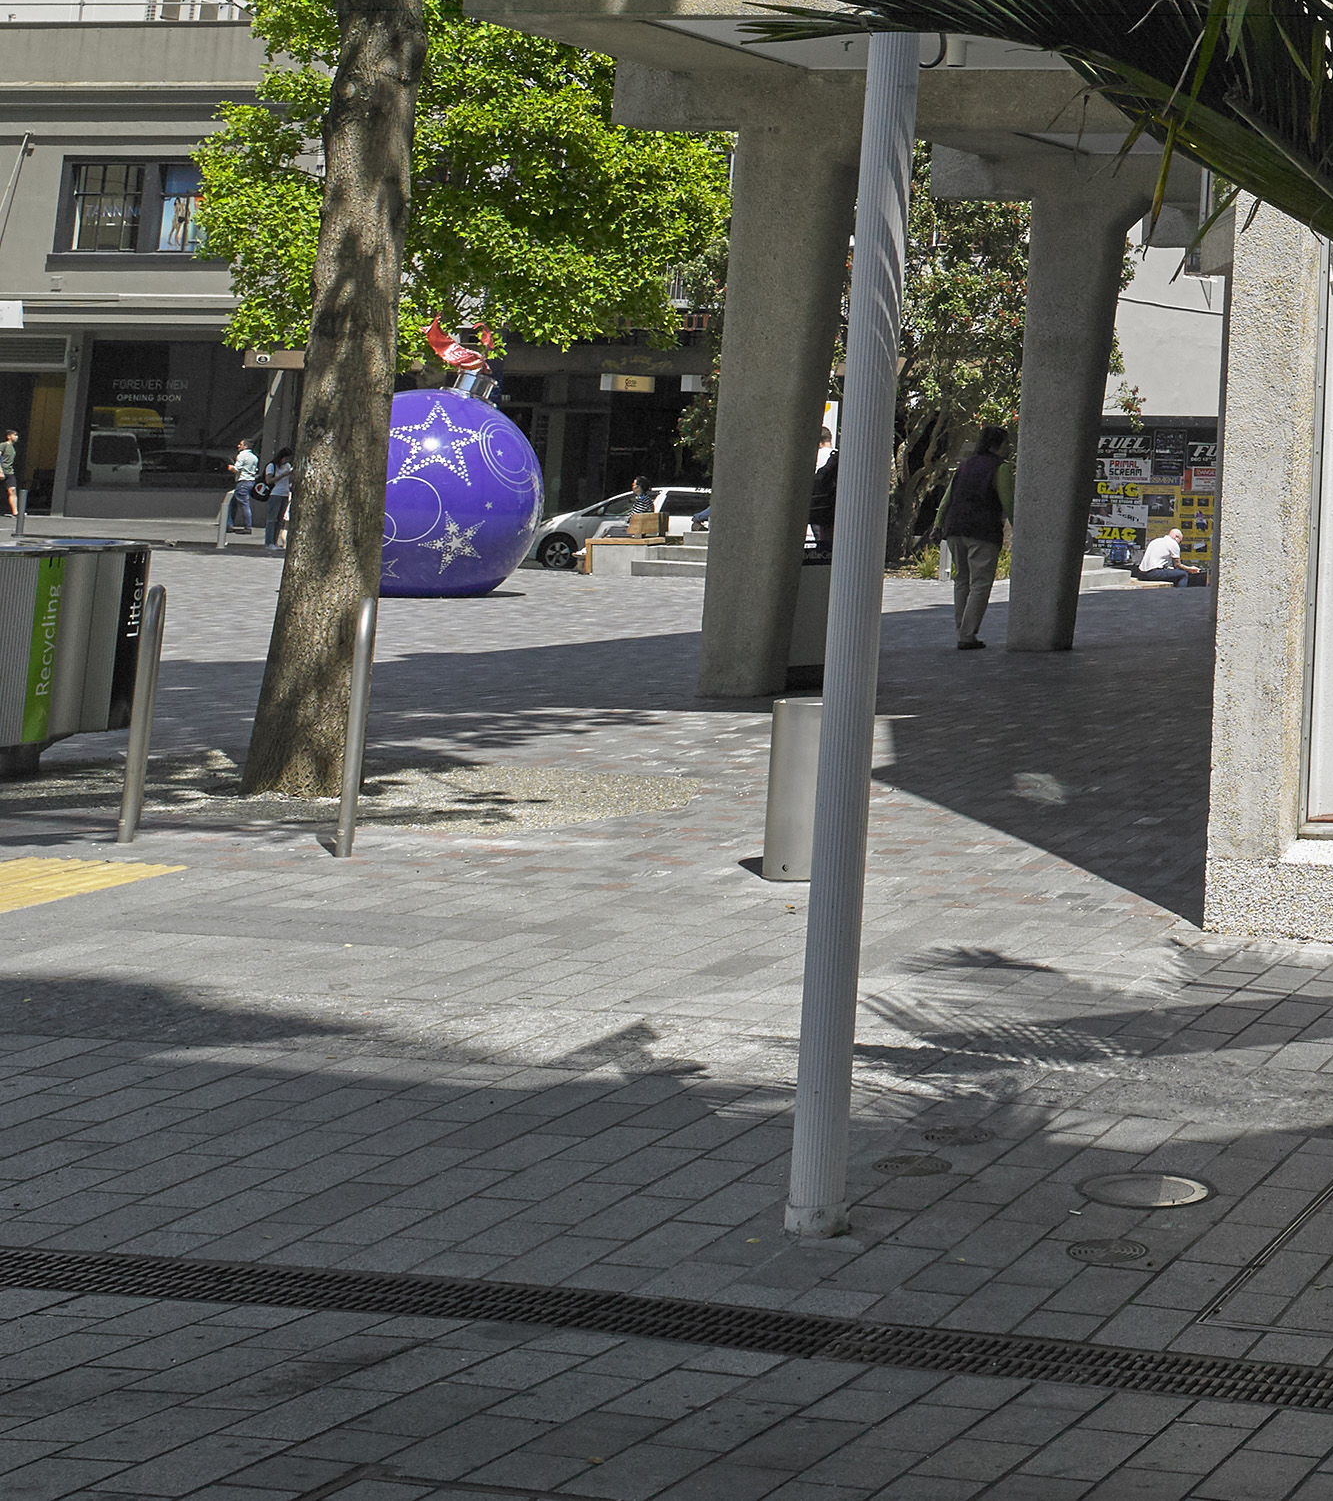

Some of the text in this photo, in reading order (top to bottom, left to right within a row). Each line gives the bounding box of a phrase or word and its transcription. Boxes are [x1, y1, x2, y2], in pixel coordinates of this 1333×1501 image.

[113, 379, 190, 390] FOREVER NEW
[117, 394, 182, 402] OPENING SOON
[1097, 437, 1145, 449] FUEL
[1109, 460, 1139, 469] PRIMAL
[1109, 468, 1142, 477] SCREAM
[126, 577, 145, 638] Litter
[35, 584, 62, 696] Recycling
